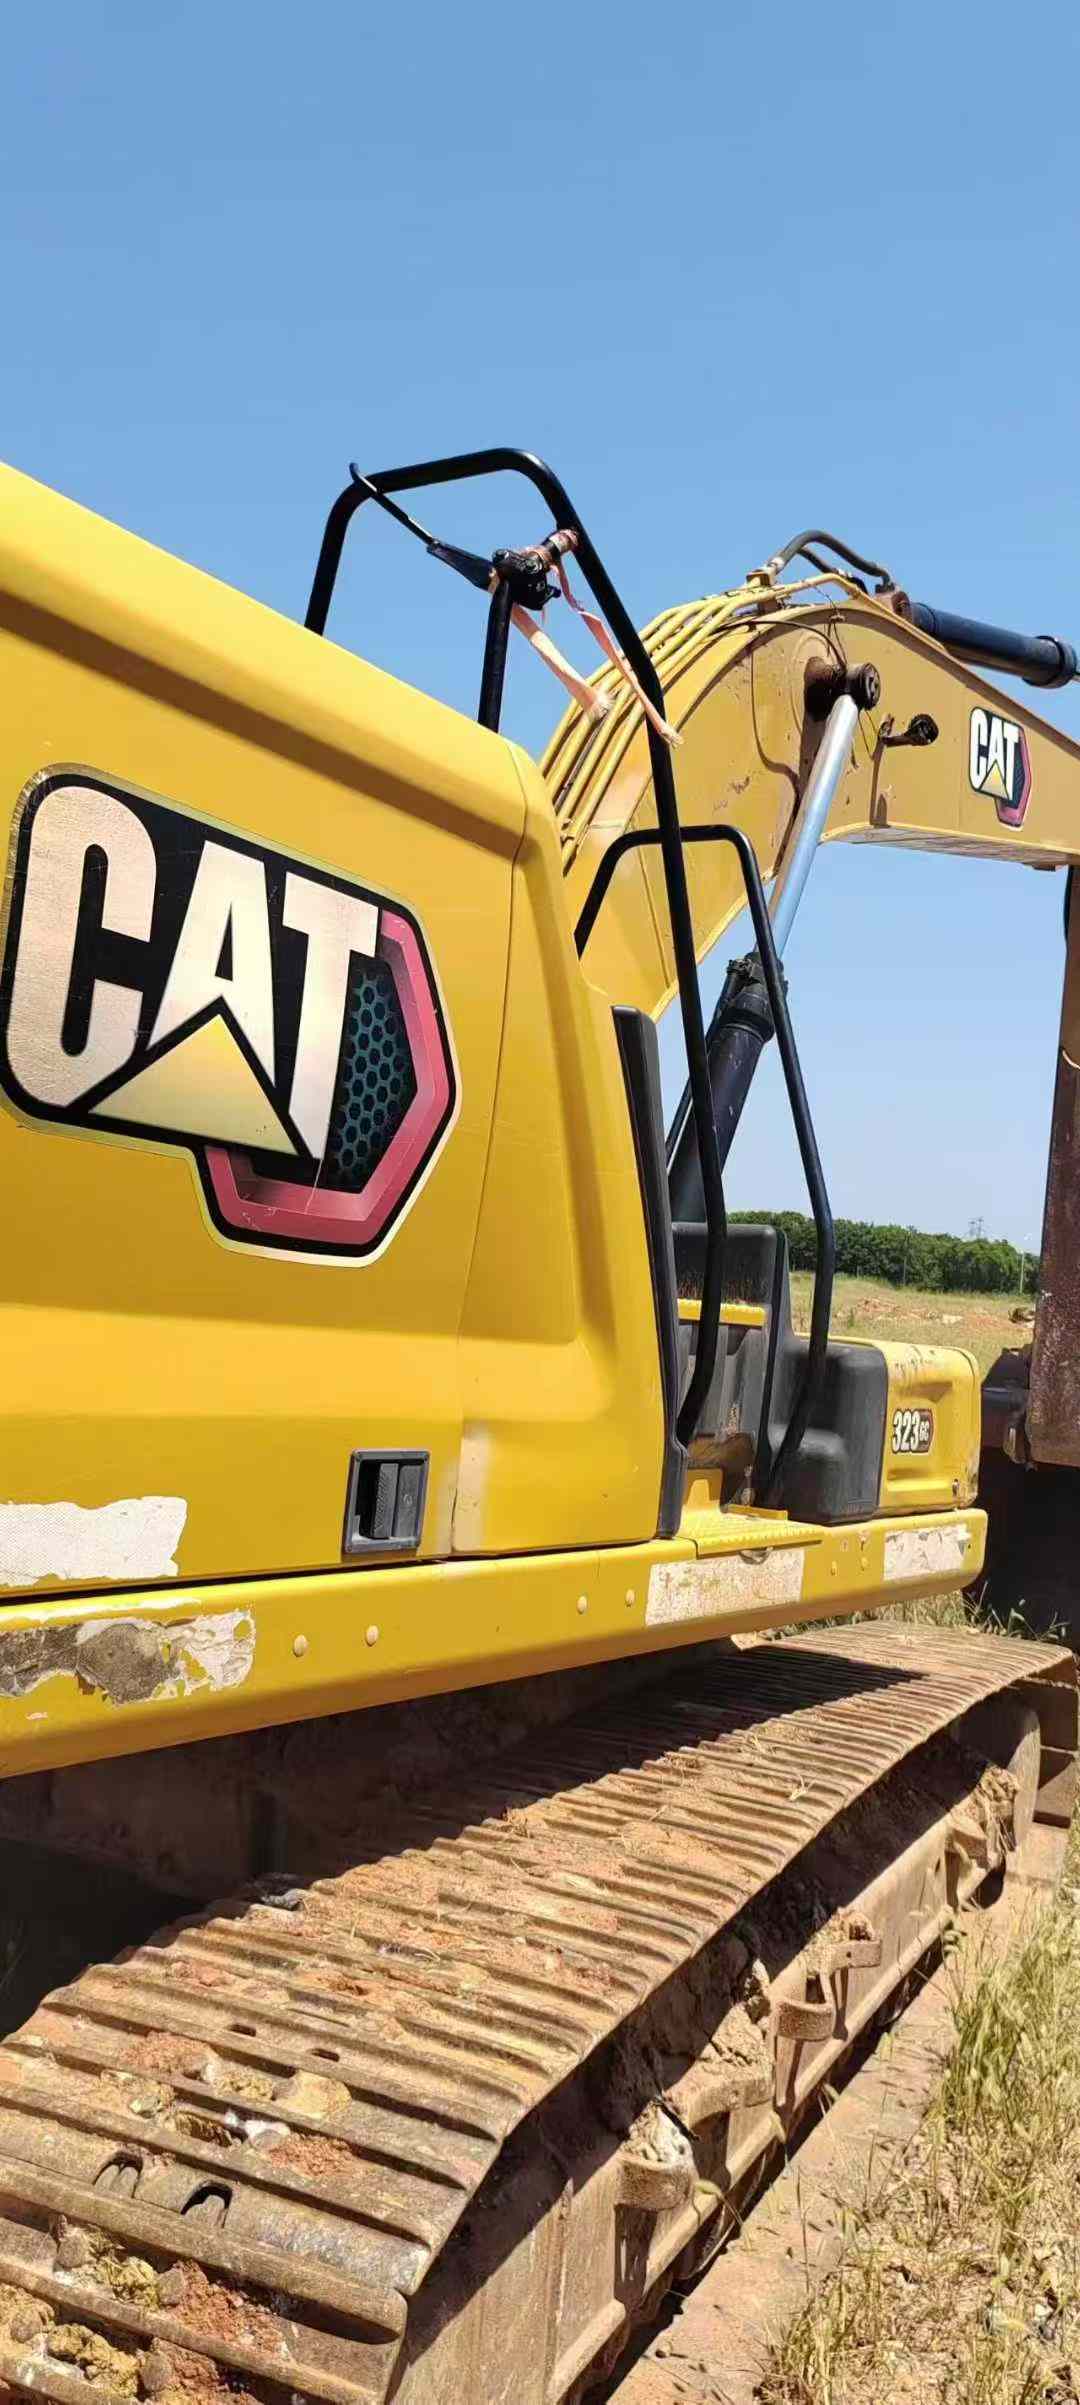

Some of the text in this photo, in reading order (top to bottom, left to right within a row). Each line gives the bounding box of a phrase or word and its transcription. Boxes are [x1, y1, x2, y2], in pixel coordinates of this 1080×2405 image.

[969, 706, 1019, 800] CAT
[6, 785, 379, 1160] CAT
[892, 1410, 920, 1452] 323
